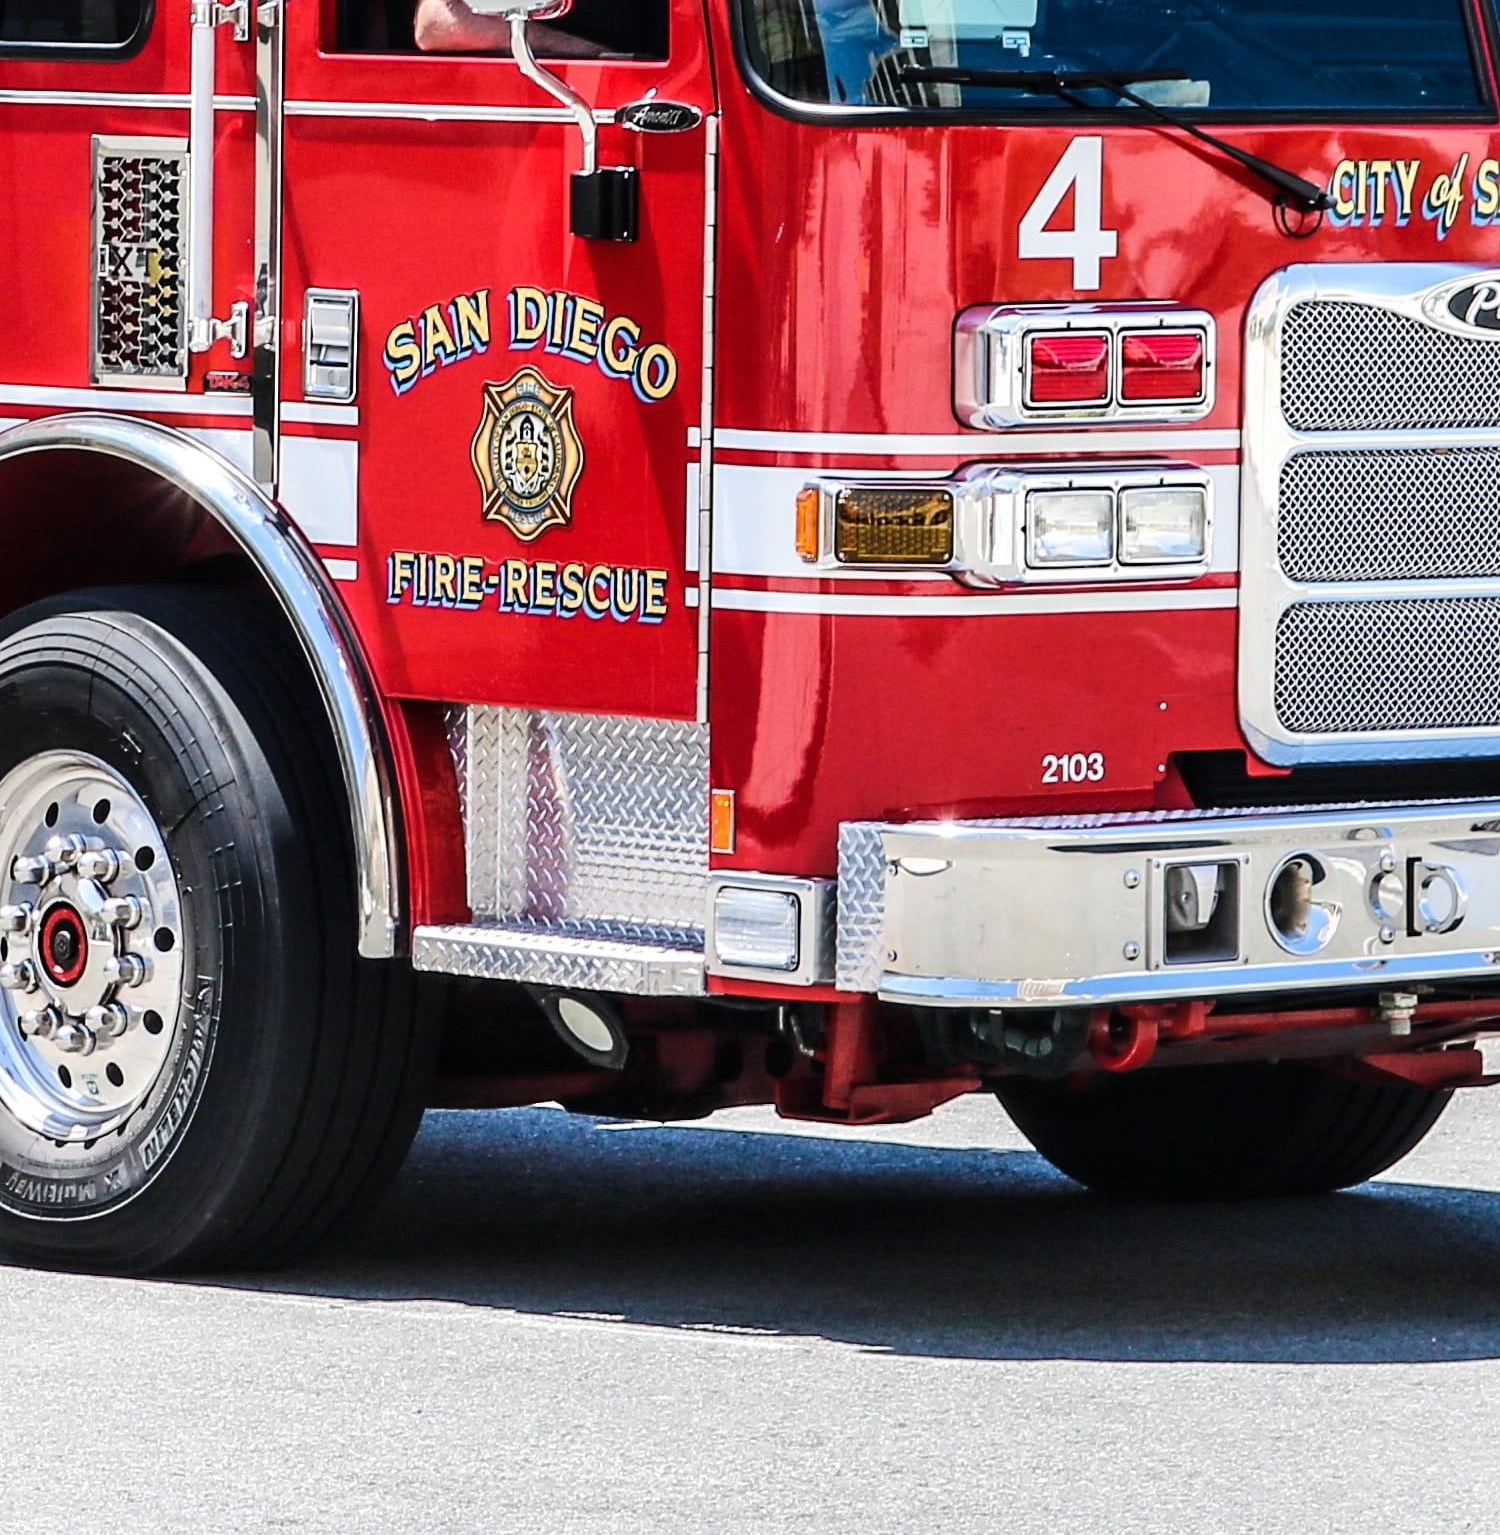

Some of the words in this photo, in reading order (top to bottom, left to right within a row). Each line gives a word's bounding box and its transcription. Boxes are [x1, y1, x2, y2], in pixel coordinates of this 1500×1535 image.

[1018, 135, 1118, 290] 4
[1329, 160, 1421, 225] CITY
[1423, 152, 1470, 237] of
[384, 288, 491, 396] SAN
[507, 286, 678, 403] DIEGO
[387, 552, 668, 623] FIRE-RESCUE
[1041, 751, 1105, 783] 2103
